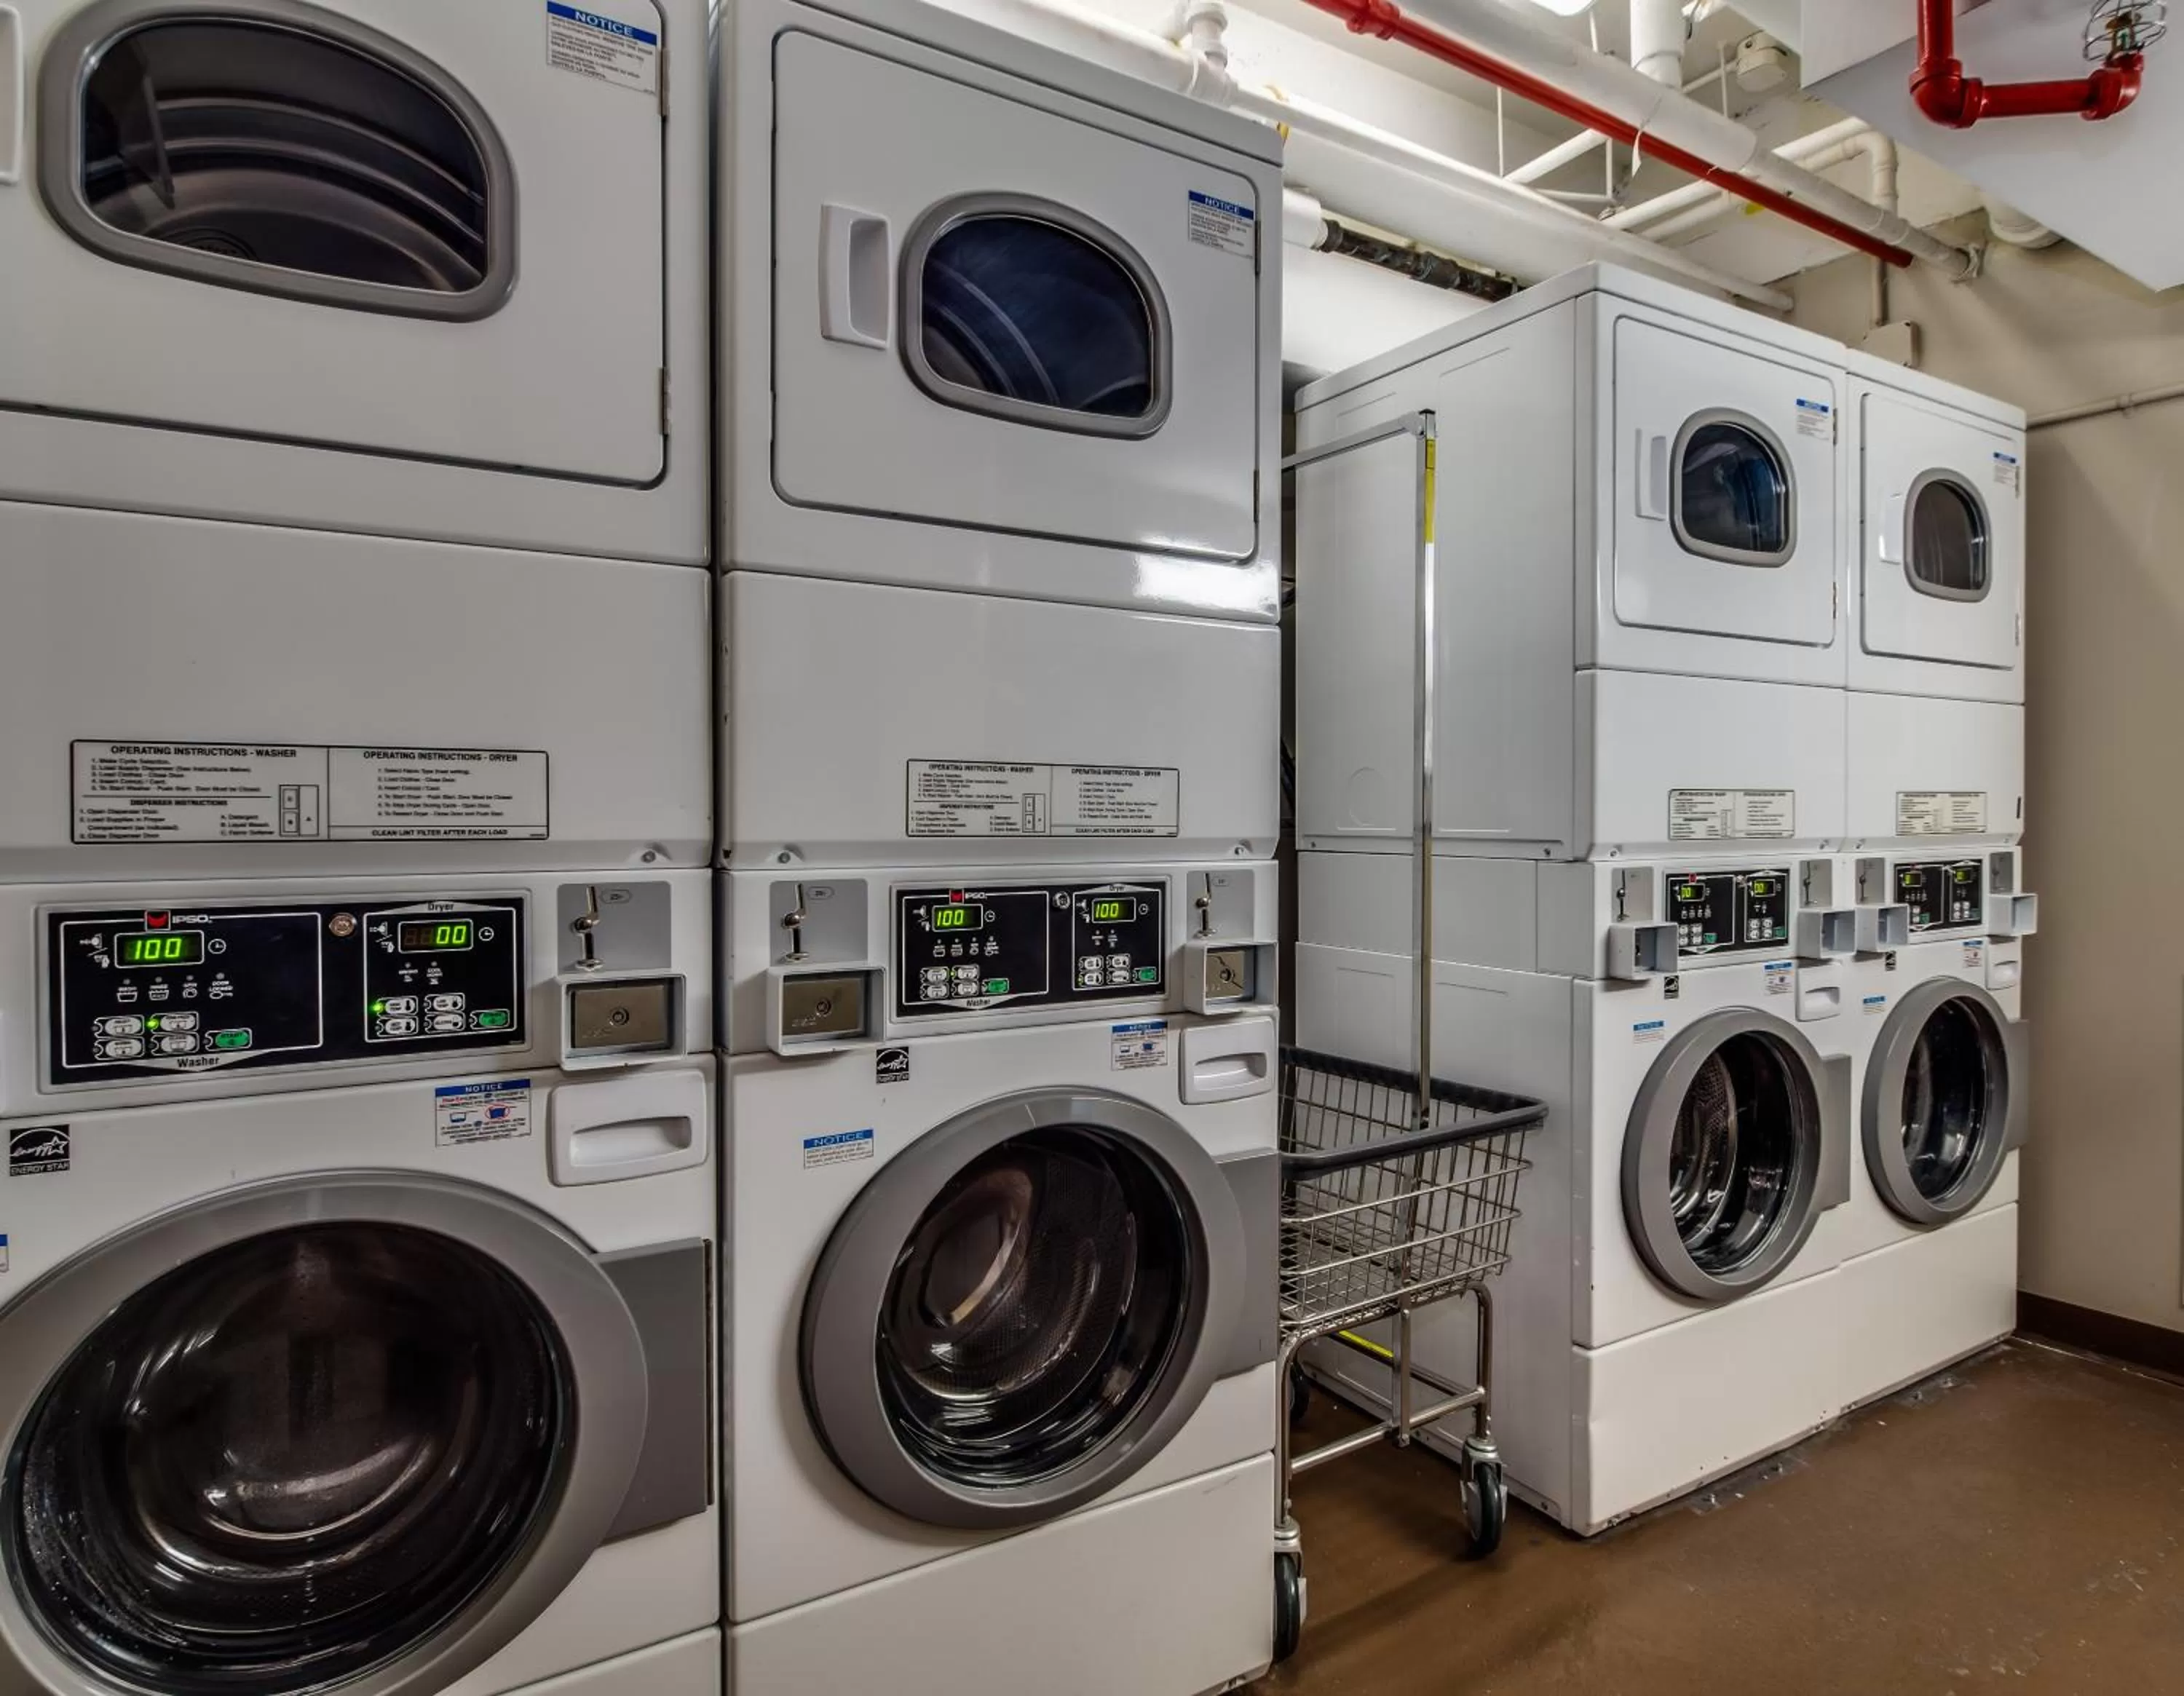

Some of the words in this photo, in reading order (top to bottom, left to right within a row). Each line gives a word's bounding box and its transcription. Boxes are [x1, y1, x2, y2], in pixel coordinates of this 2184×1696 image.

[575, 11, 633, 36] NOTICE
[111, 745, 171, 755] OPERATING
[174, 747, 248, 756] INSTRUCTIONS
[256, 749, 296, 757] WASHER
[363, 750, 416, 759] OPERATING
[427, 902, 455, 911] Dryer
[1096, 902, 1119, 919] 100
[936, 908, 965, 927] 100
[436, 924, 467, 945] 00
[134, 937, 182, 960] 100
[177, 1055, 221, 1069] Washer
[465, 1082, 503, 1093] NOTICE
[814, 1131, 863, 1146] NOTICE
[11, 1165, 45, 1175] ENERGY
